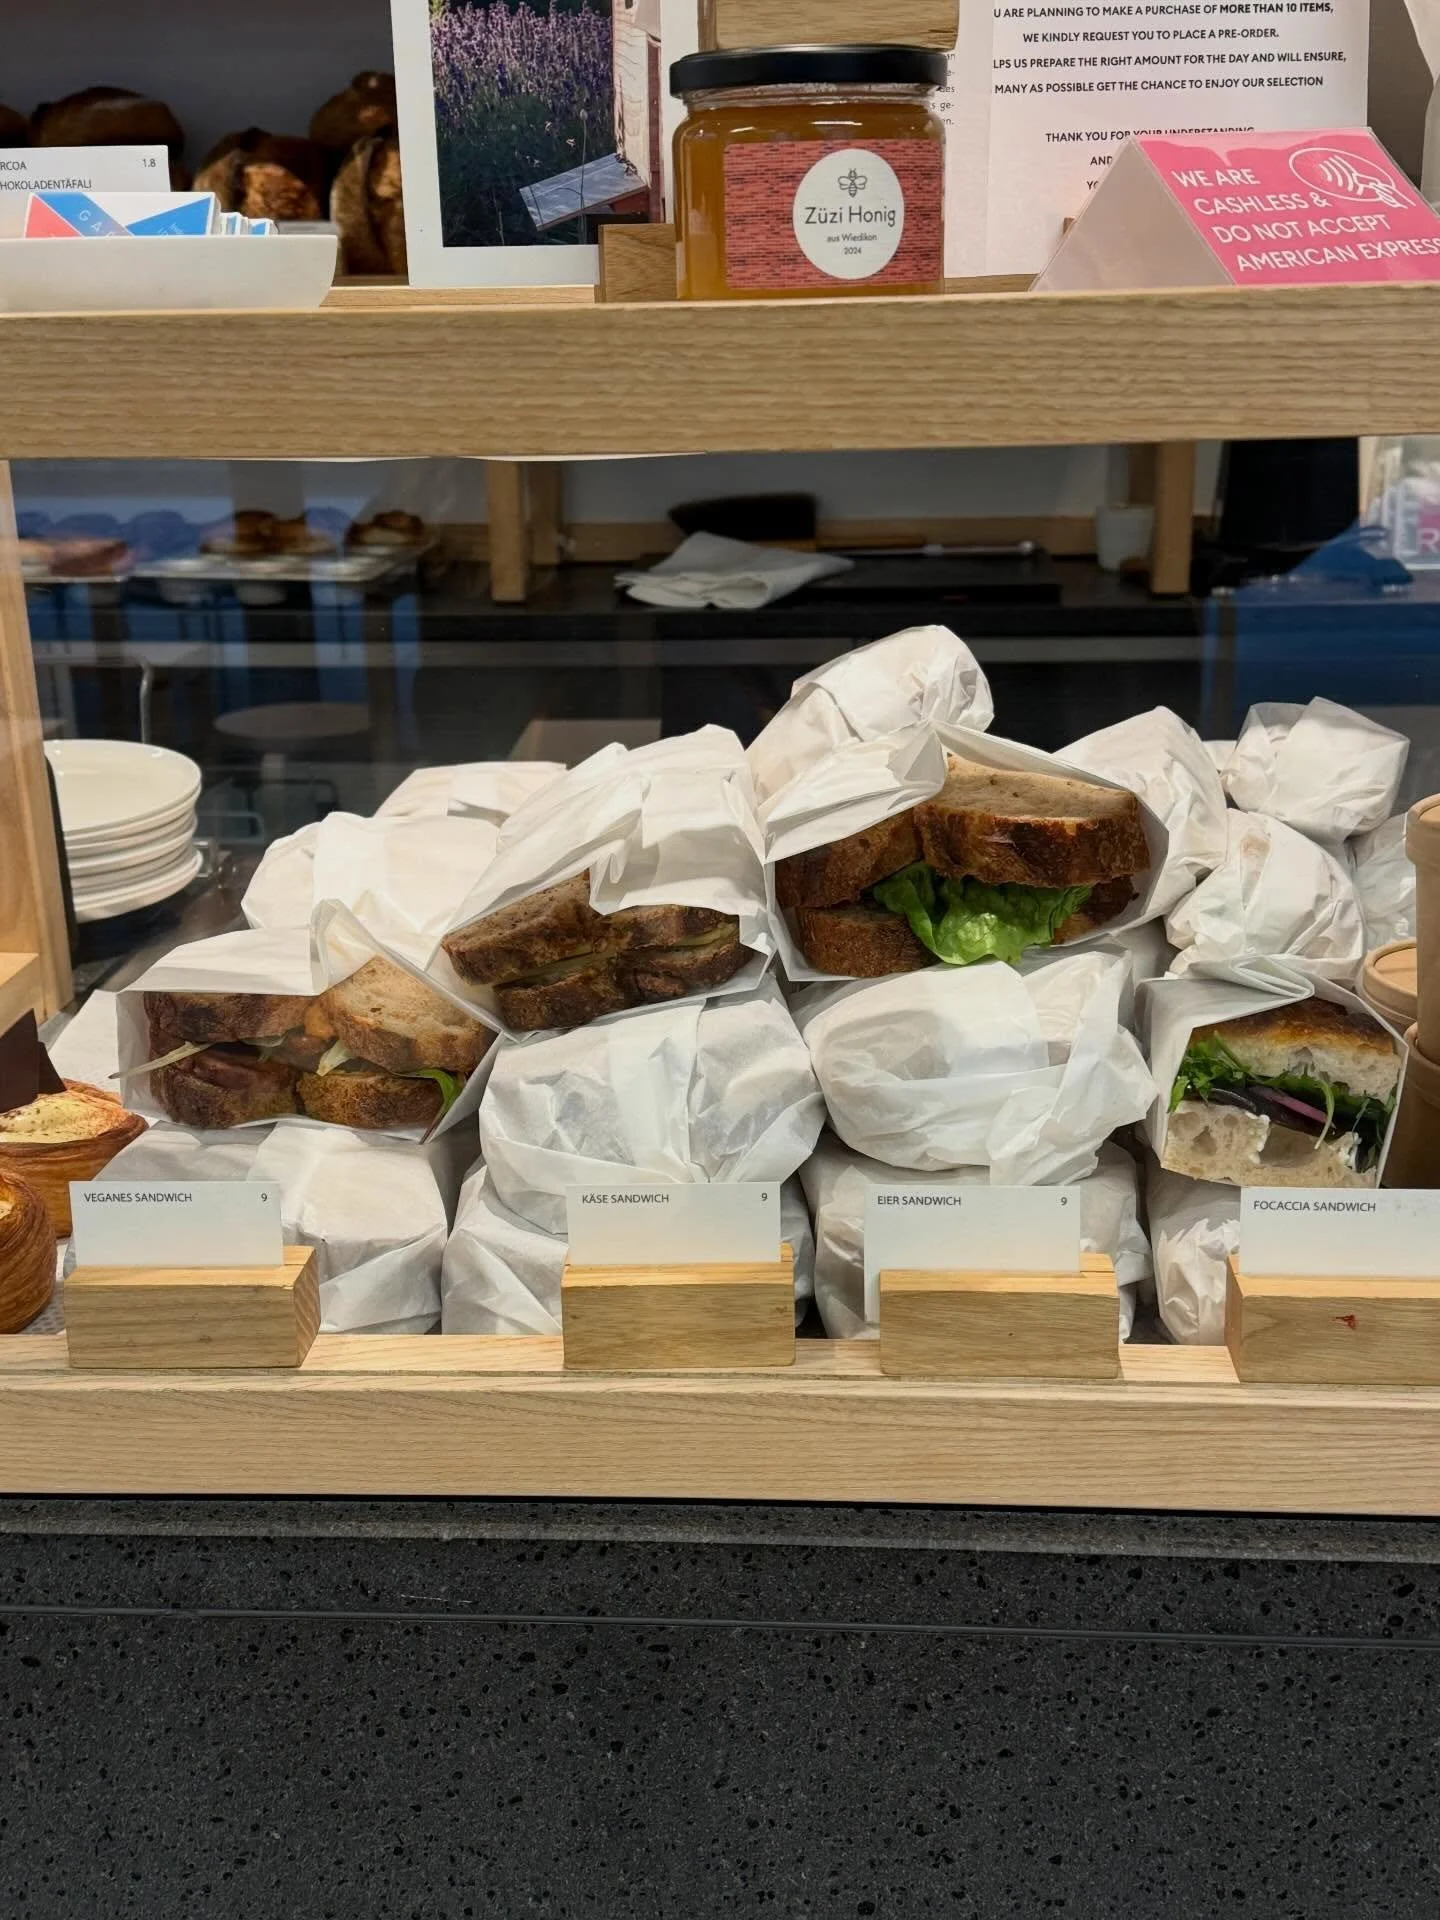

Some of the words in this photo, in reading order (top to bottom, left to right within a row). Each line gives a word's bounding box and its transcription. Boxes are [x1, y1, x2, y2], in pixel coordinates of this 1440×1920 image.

[1003, 8, 1025, 17] ARE
[1027, 7, 1083, 17] PLANNING
[1086, 6, 1100, 16] TO
[1103, 6, 1133, 16] MAKE
[1135, 6, 1143, 16] A
[1145, 5, 1201, 15] PURCHASE
[1203, 4, 1218, 14] OF
[1220, 4, 1250, 14] MORE
[1253, 3, 1283, 13] THAN
[1286, 3, 1297, 13] 10
[1300, 2, 1334, 14] ITEMS,
[1023, 33, 1039, 43] WE
[1042, 32, 1080, 43] KINDLY
[1082, 31, 1129, 42] REQUEST
[1132, 31, 1154, 41] YOU
[1156, 30, 1171, 40] TO
[1173, 30, 1206, 40] PLACE
[1208, 30, 1217, 39] A
[1218, 28, 1279, 39] PRE-ORDER.
[1013, 58, 1028, 69] US
[1030, 57, 1076, 68] PREPARE
[1078, 57, 1098, 67] THE
[1100, 56, 1132, 67] RIGHT
[1134, 55, 1181, 66] AMOUNT
[1183, 55, 1204, 65] FOR
[1207, 54, 1226, 64] THE
[1229, 53, 1249, 63] DAY
[1251, 53, 1275, 63] AND
[1277, 52, 1302, 62] WILL
[1303, 51, 1347, 62] ENSURE,
[994, 84, 1028, 94] MANY
[1029, 83, 1044, 93] AS
[1046, 82, 1094, 93] POSSIBLE
[1097, 81, 1116, 91] GET
[1118, 81, 1138, 91] THE
[1140, 80, 1187, 90] CHANCE
[1189, 79, 1203, 89] TO
[1205, 78, 1241, 89] ENJOY
[1242, 78, 1265, 88] OUR
[1267, 76, 1324, 87] SELECTION
[1045, 131, 1083, 142] THANK
[1085, 131, 1108, 141] YOU
[142, 158, 157, 168] 1.8
[1171, 170, 1213, 188] WE
[1215, 168, 1261, 187] ARE
[1194, 192, 1309, 215] CASHLESS
[1309, 191, 1331, 208] &
[805, 207, 843, 225] Züzi
[849, 205, 896, 228] Honig
[1211, 225, 1252, 244] DO
[1254, 221, 1302, 241] NOT
[1308, 214, 1392, 238] ACCEPT
[841, 233, 878, 241] Wiedikon
[844, 247, 862, 255] 2024
[1236, 245, 1359, 272] AMERICAN
[1356, 237, 1440, 260] EXPRESS
[84, 1192, 133, 1202] VEGANES
[135, 1193, 193, 1202] SANDWICH
[261, 1193, 268, 1202] 9
[582, 1193, 608, 1204] KÄSE
[610, 1194, 670, 1204] SANDWICH
[761, 1192, 768, 1202] 9
[877, 1195, 900, 1206] EIER
[901, 1196, 962, 1206] SANDWICH
[1060, 1197, 1068, 1206] 9
[1253, 1200, 1311, 1212] FOCACCIA
[1313, 1201, 1376, 1212] SANDWICH
